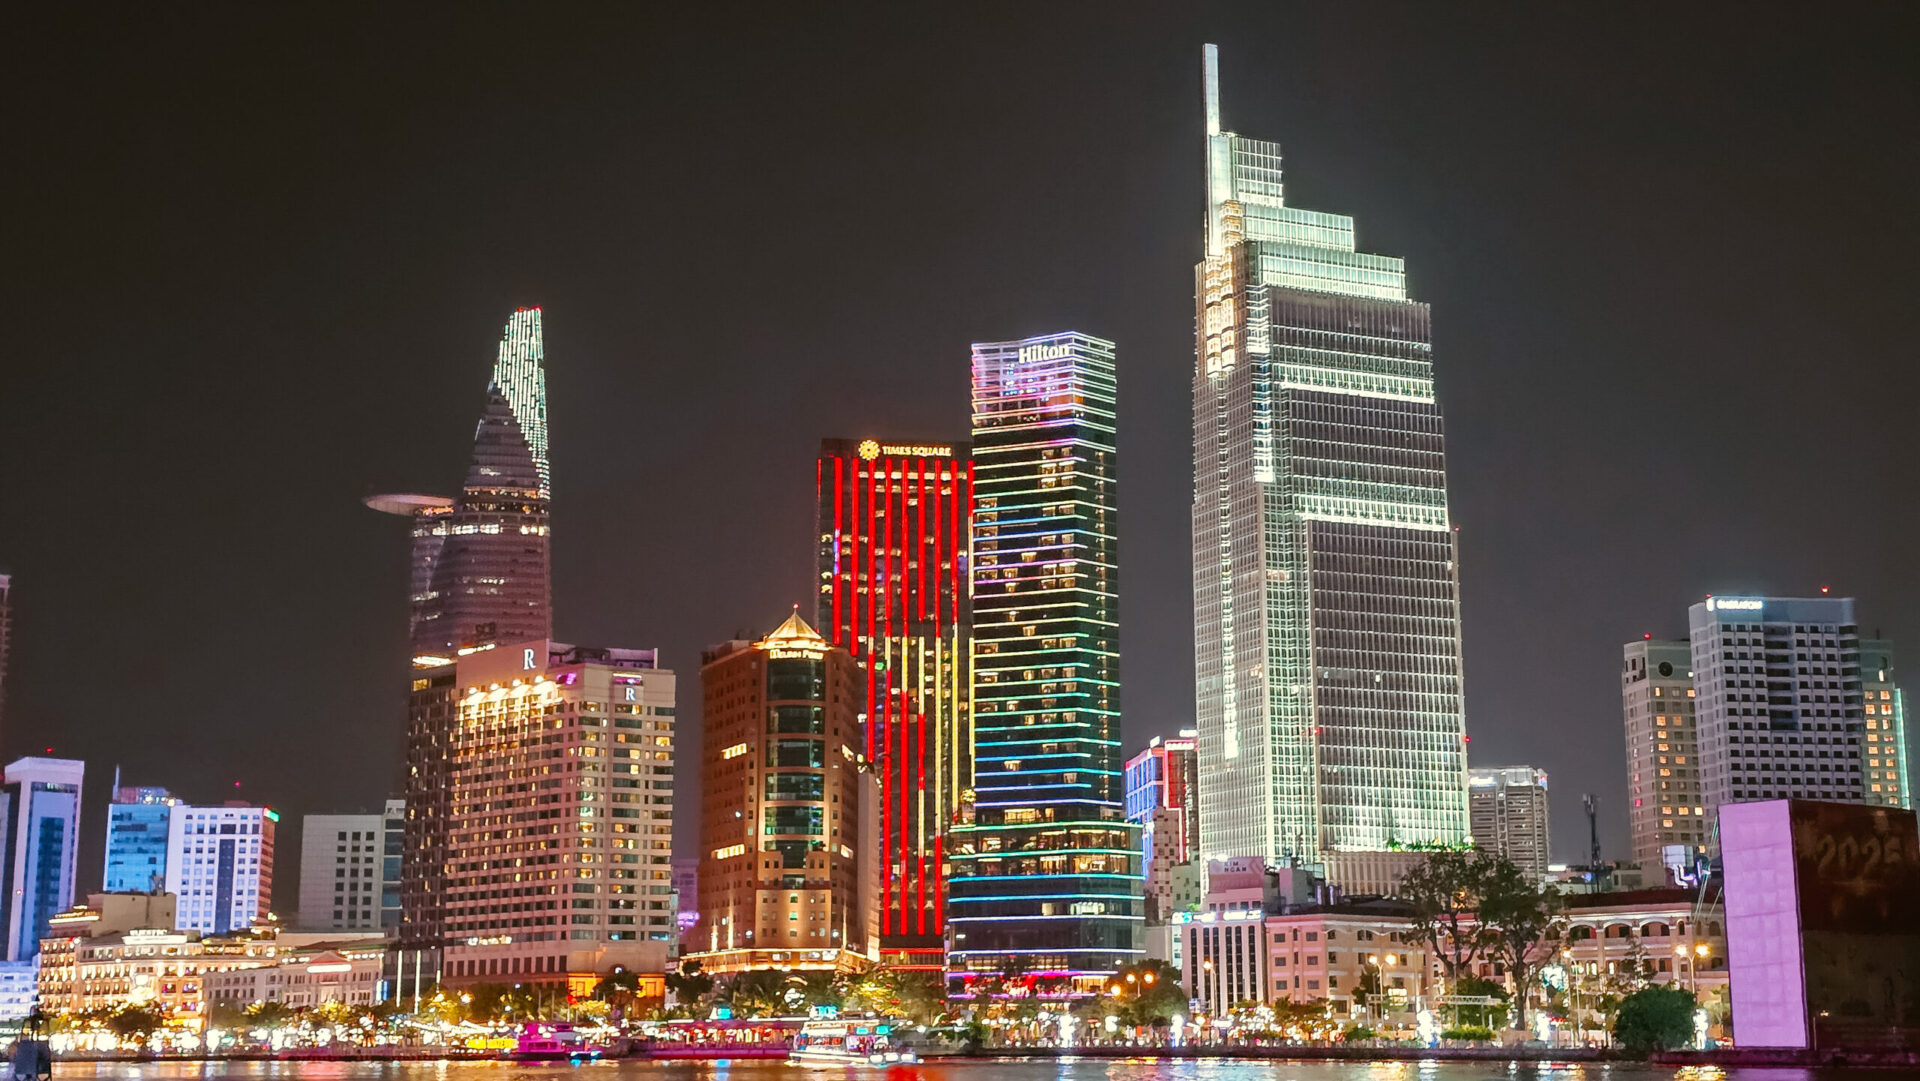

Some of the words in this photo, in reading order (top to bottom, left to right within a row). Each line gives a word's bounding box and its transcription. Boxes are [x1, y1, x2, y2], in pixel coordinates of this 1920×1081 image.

[1019, 343, 1070, 364] Hilton
[882, 446, 911, 456] TIMES
[912, 446, 952, 457] SQUARE
[523, 648, 537, 670] R
[625, 687, 637, 701] R
